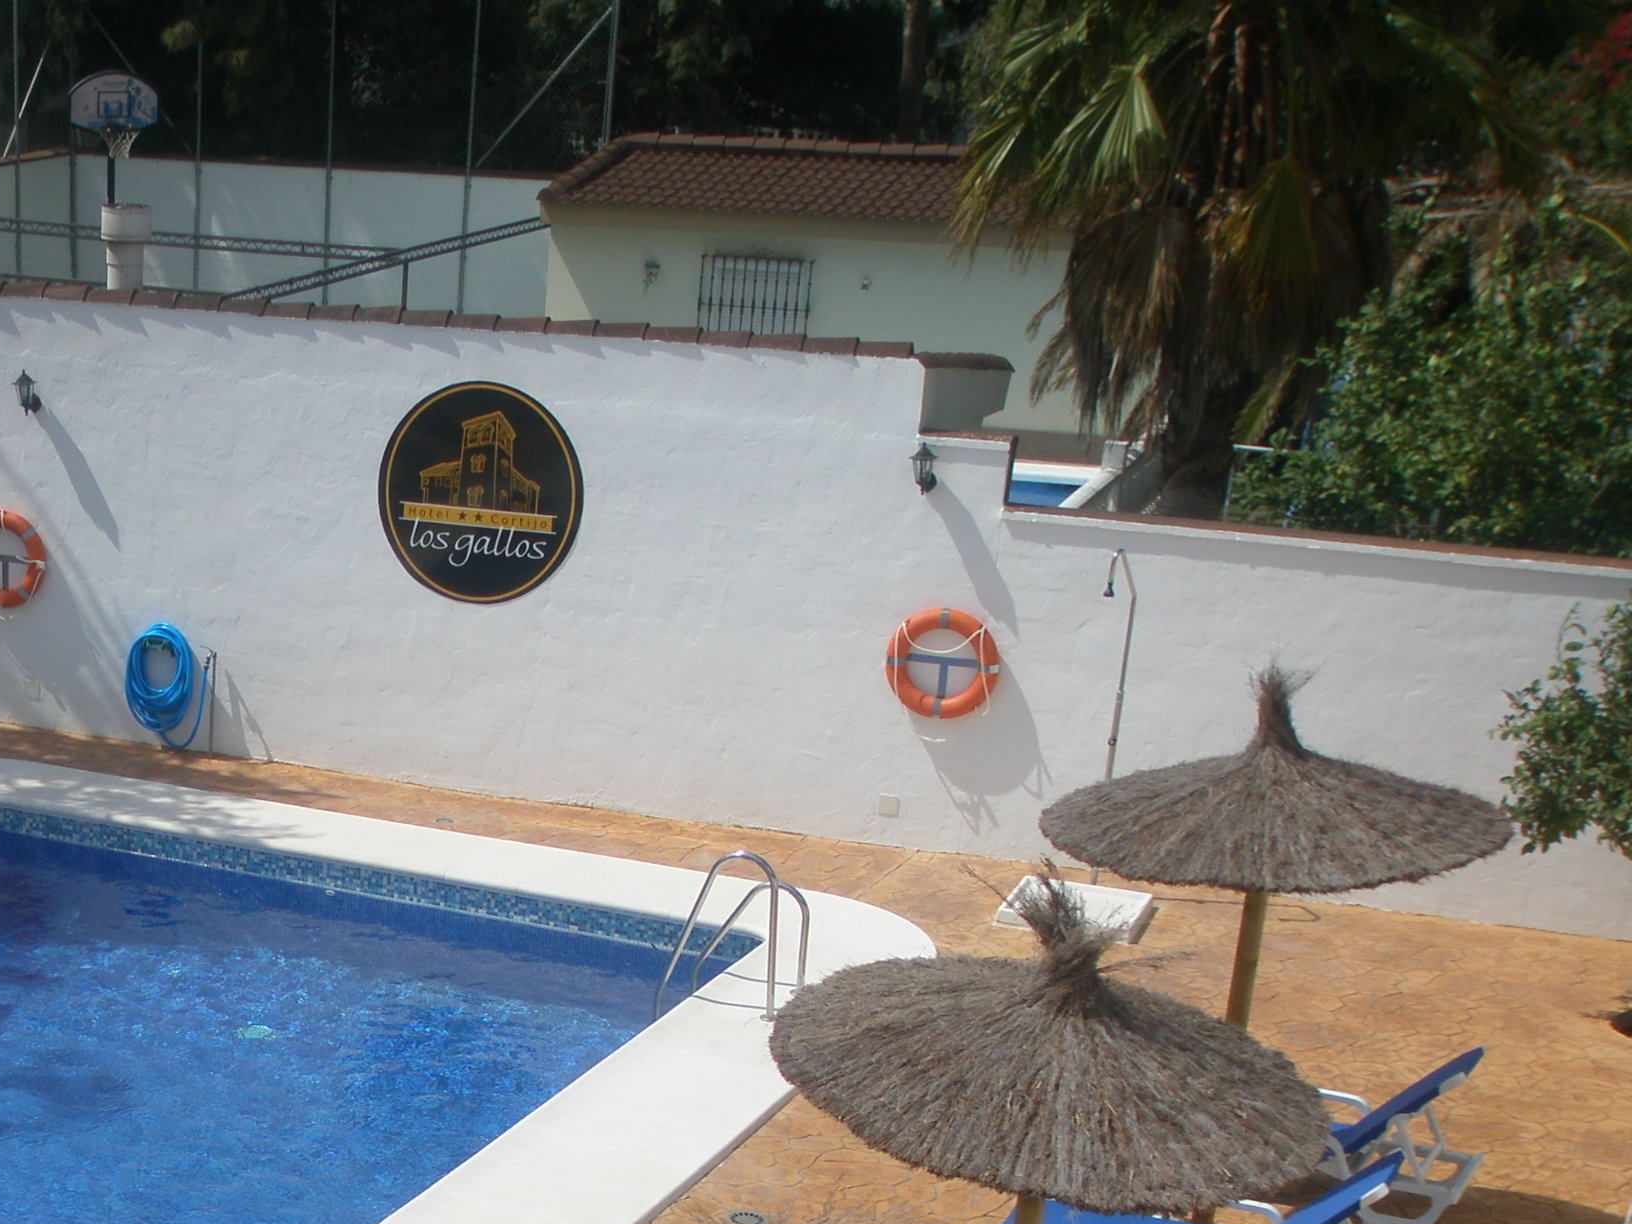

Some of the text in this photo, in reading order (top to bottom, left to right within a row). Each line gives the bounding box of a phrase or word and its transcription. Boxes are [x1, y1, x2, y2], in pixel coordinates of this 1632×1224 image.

[408, 507, 548, 530] Hotel Cortijo
[409, 519, 548, 567] los gallos
